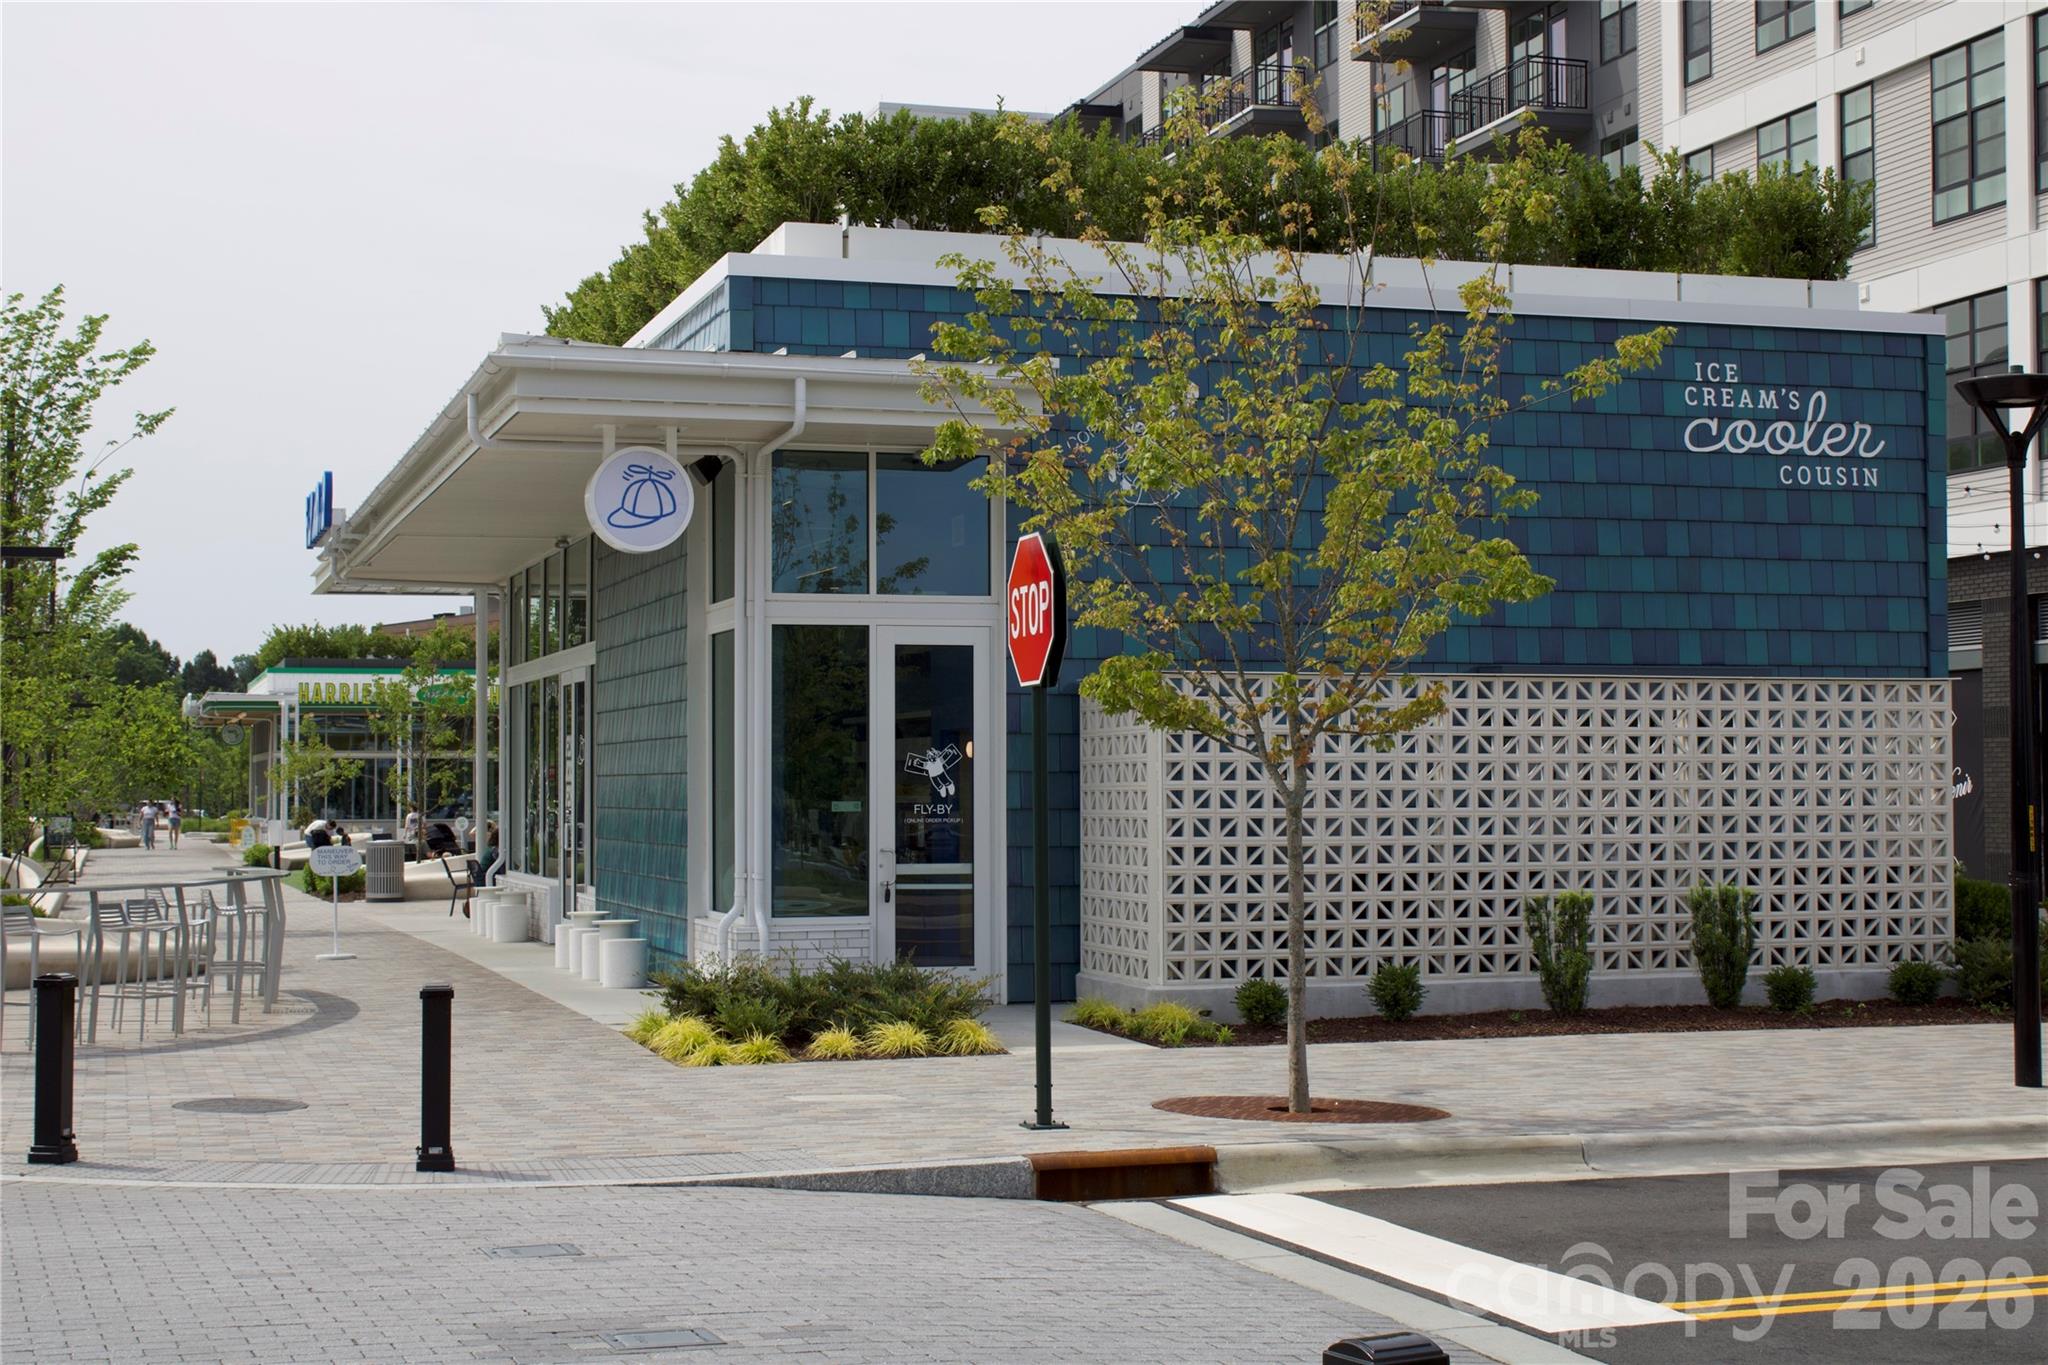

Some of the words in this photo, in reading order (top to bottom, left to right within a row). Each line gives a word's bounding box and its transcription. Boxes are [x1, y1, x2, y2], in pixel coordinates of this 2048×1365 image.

[1695, 362, 1738, 383] ICE
[1684, 386, 1800, 410] CREAM'S
[1684, 390, 1886, 458] cooler
[1779, 465, 1878, 487] COUSIN
[1011, 580, 1049, 640] STOP
[913, 804, 953, 815] FLY-BY
